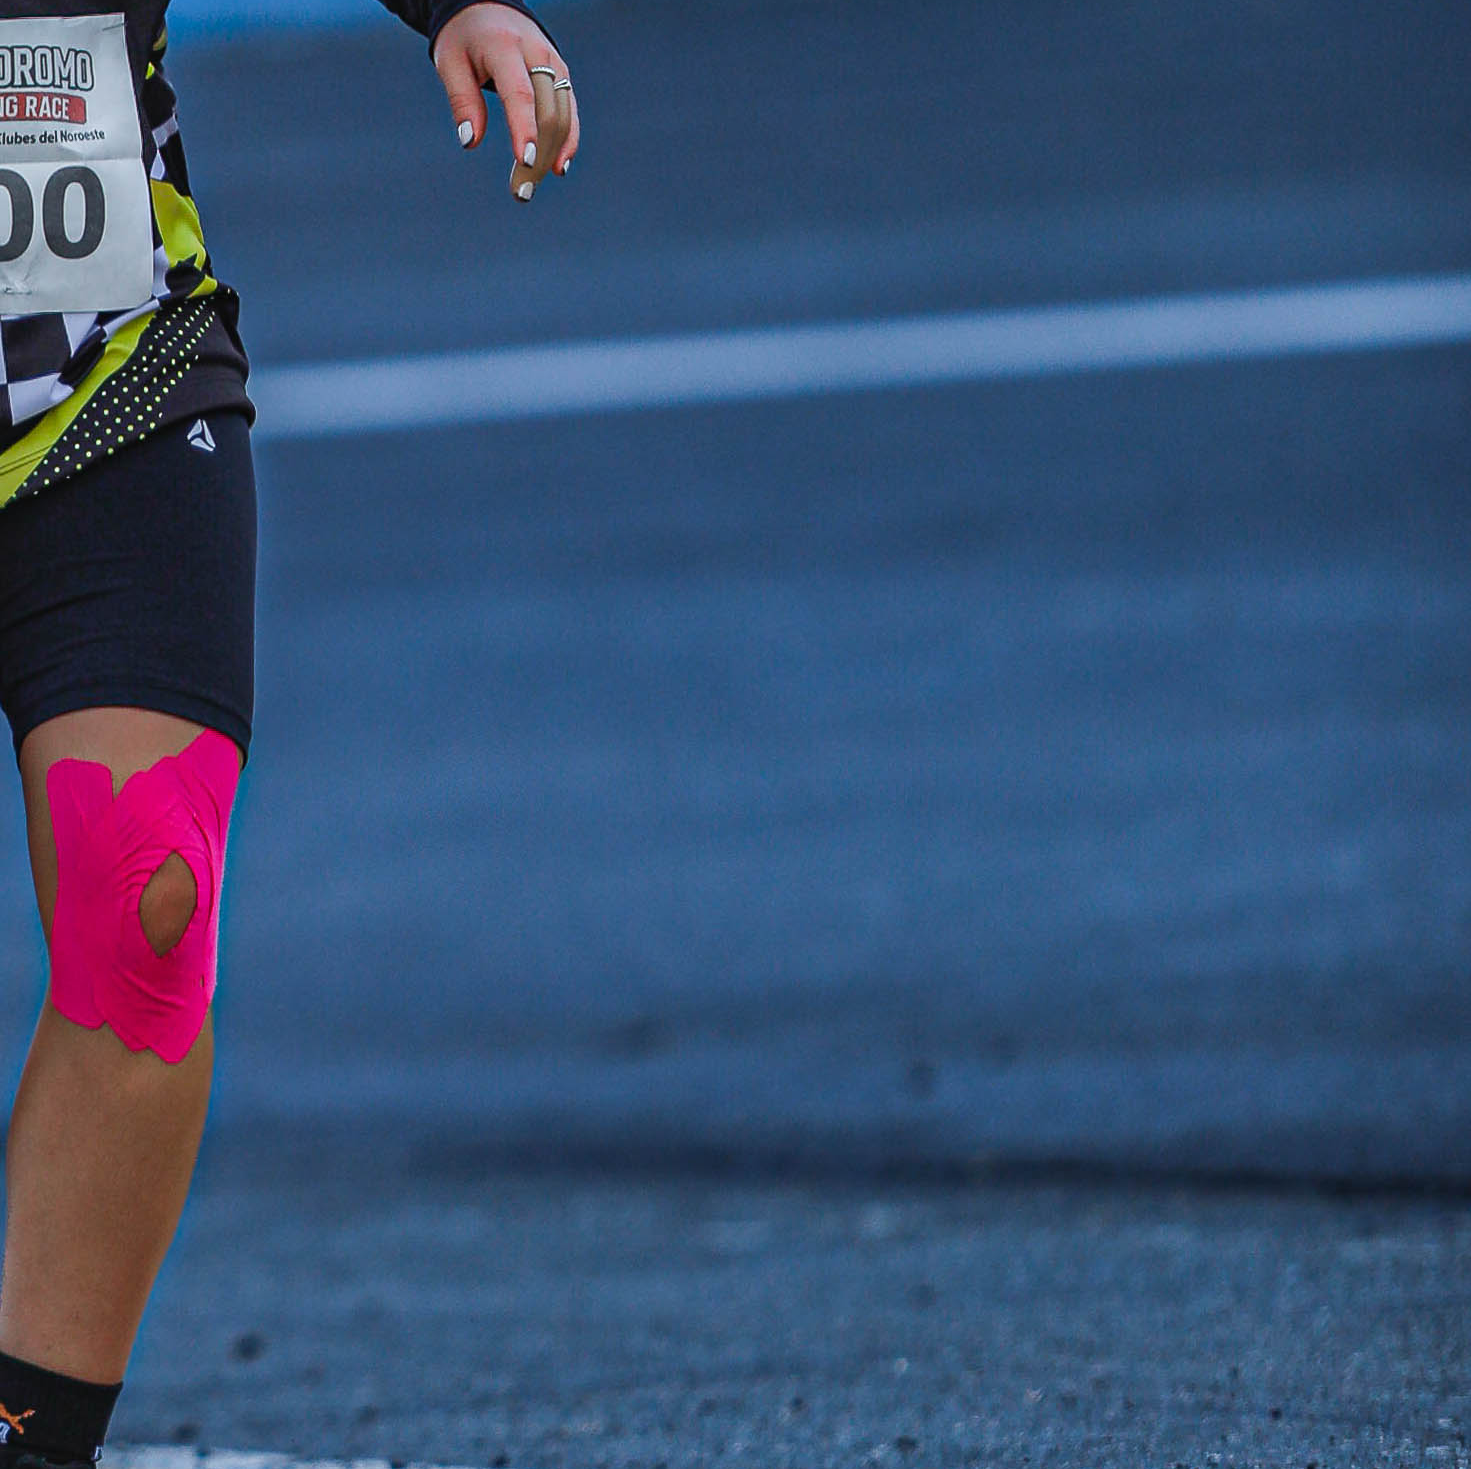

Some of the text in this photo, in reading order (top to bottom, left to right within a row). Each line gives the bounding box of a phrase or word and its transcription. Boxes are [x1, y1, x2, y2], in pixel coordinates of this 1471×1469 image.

[25, 95, 70, 120] RACE
[39, 130, 58, 144] del
[60, 129, 106, 142] Noroeste
